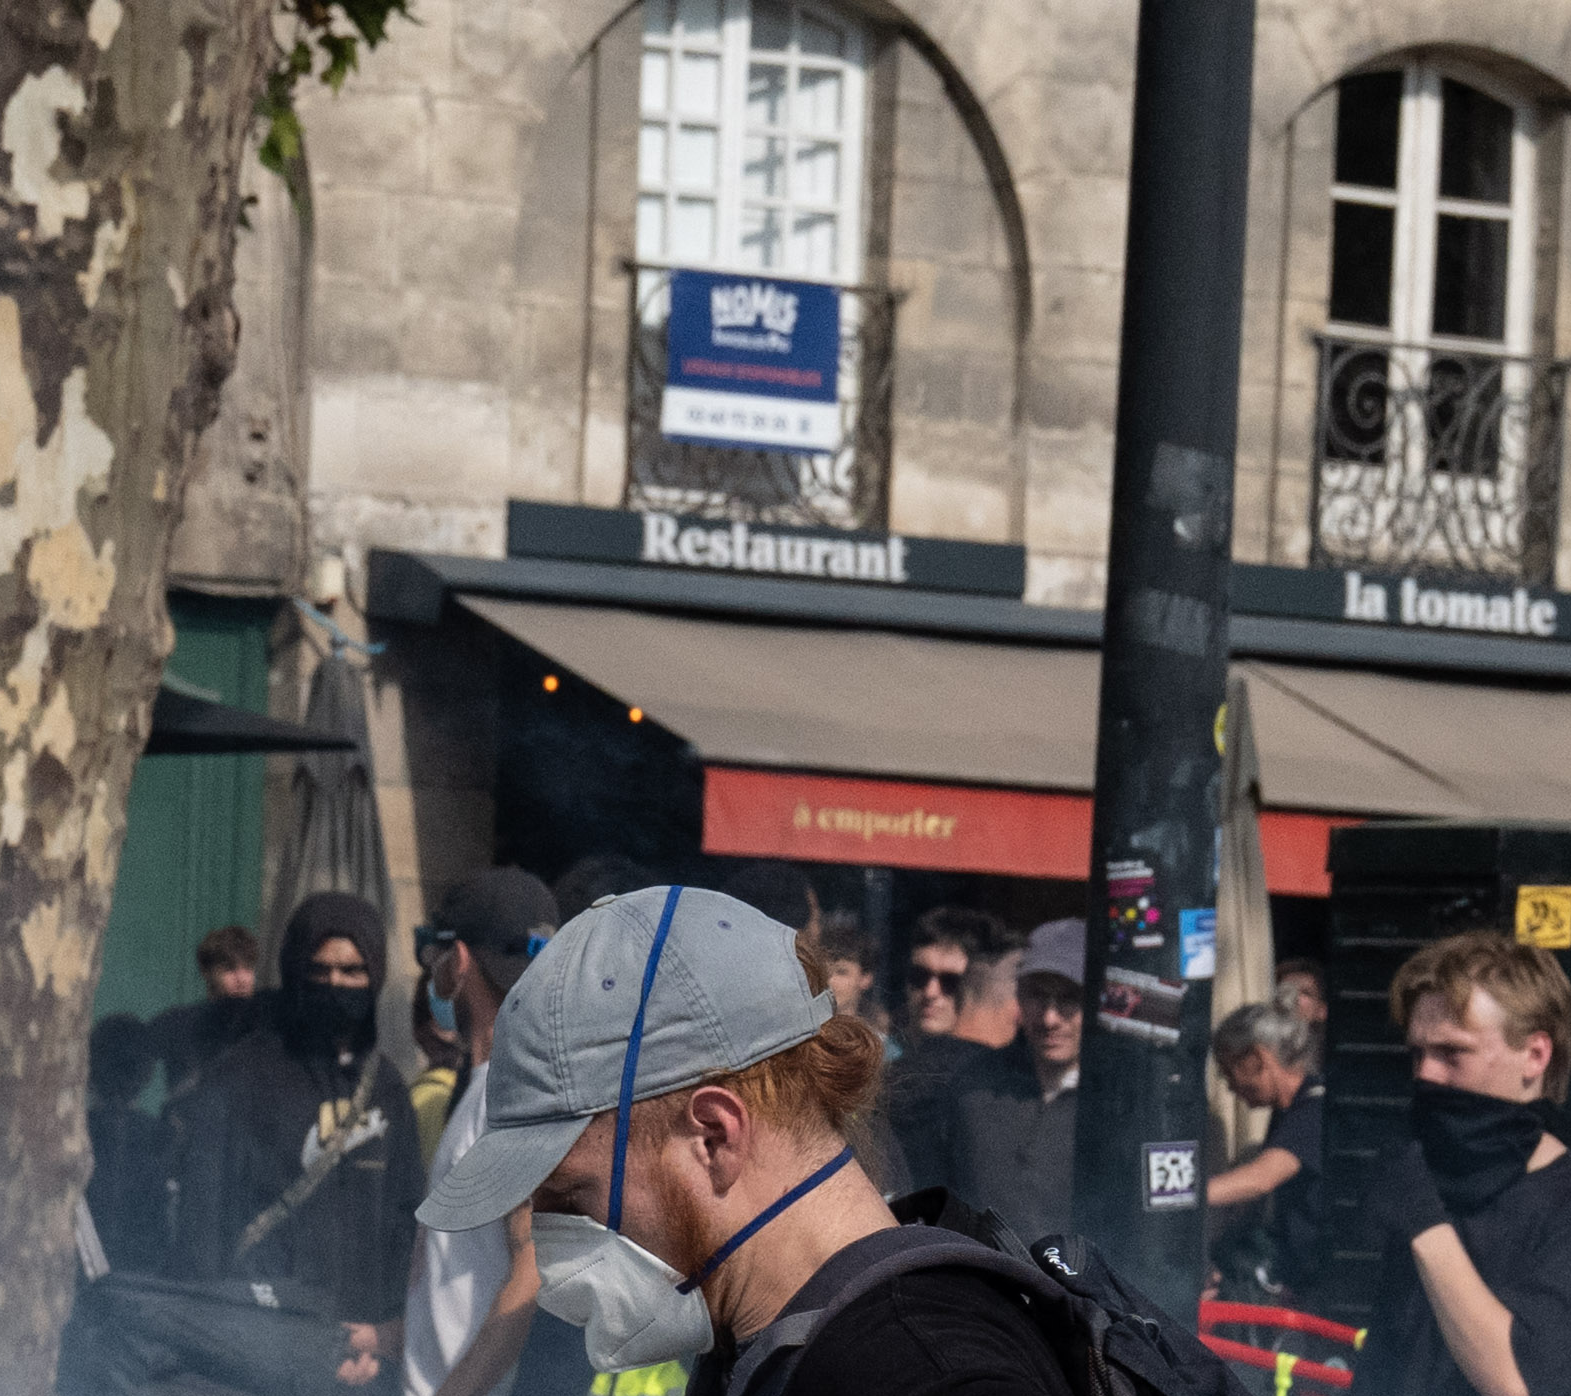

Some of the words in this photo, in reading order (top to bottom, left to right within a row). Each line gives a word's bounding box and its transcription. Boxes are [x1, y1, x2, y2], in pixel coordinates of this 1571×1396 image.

[641, 511, 907, 584] Restaurant
[1344, 570, 1388, 622] la
[1400, 576, 1559, 637] tomate
[816, 807, 958, 841] emporter
